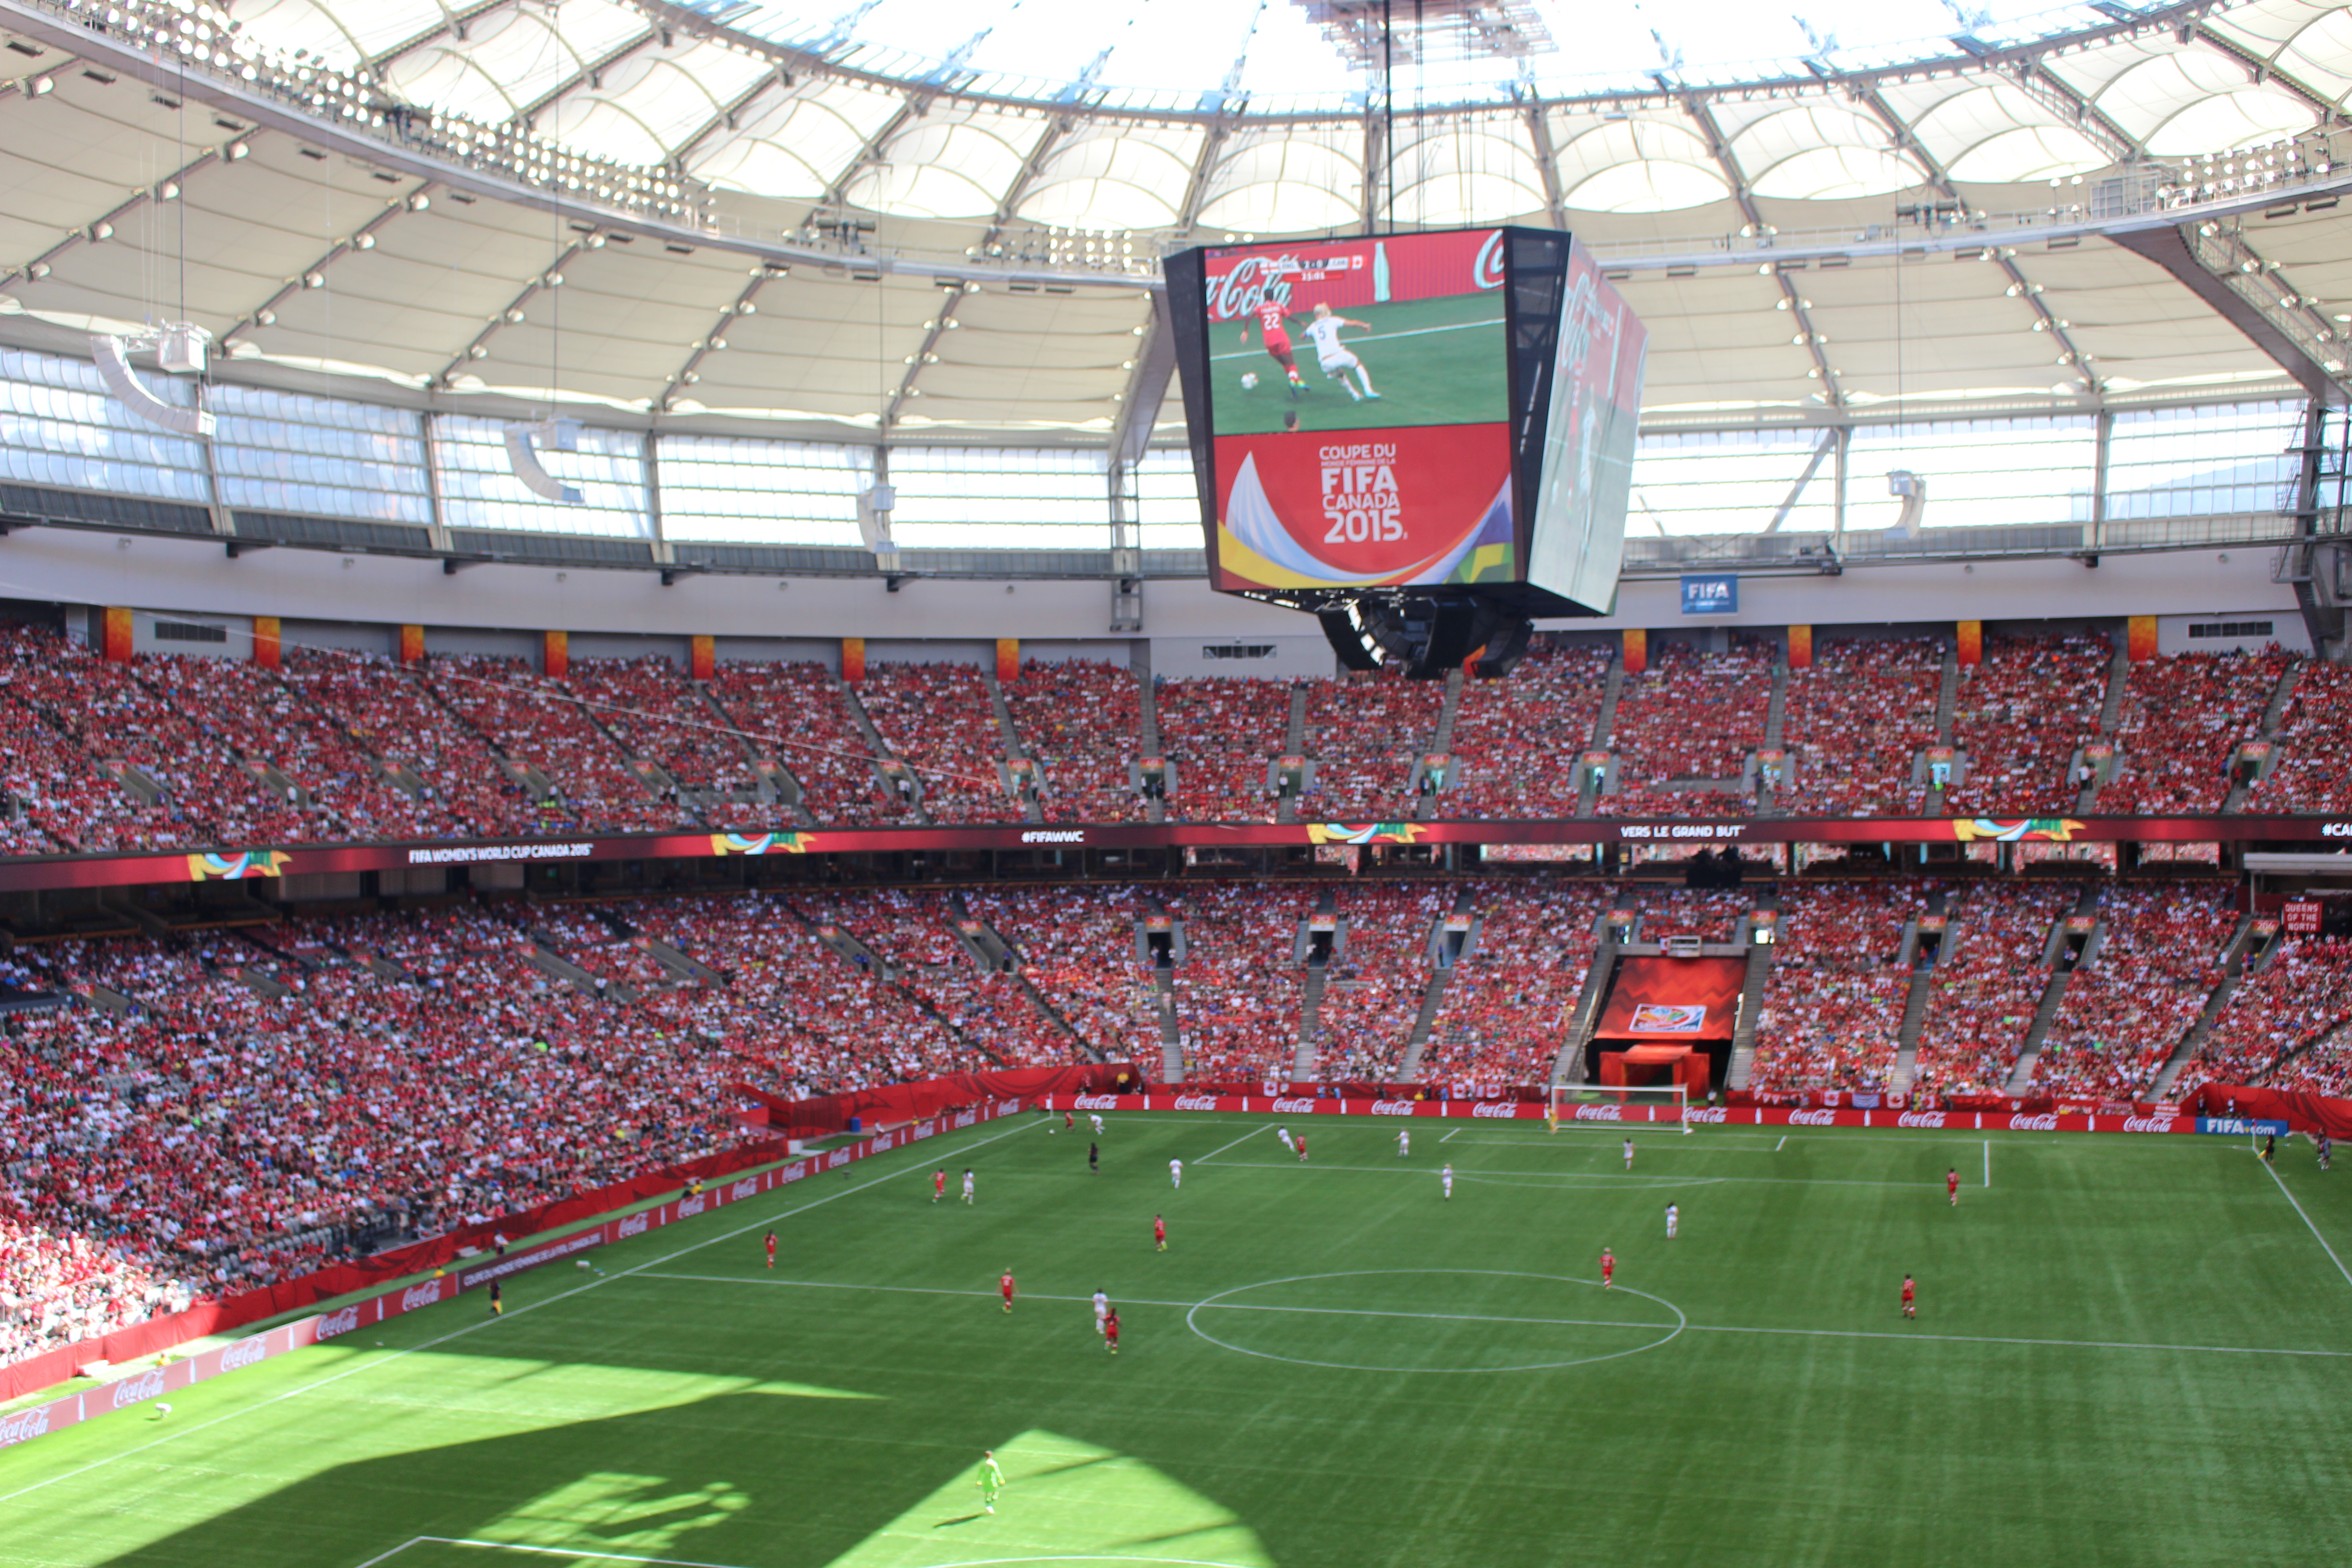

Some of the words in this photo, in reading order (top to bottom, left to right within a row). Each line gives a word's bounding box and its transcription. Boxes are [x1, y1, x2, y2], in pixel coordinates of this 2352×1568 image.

[1263, 313, 1280, 330] 22
[1318, 326, 1326, 340] 5
[1319, 444, 1371, 460] COUPE
[1373, 443, 1396, 458] DU
[1322, 465, 1399, 495] FIFA
[1322, 492, 1400, 510] CANADA
[1323, 508, 1403, 544] 2015
[1688, 582, 1730, 599] FIFA
[1021, 830, 1084, 843] #FIFAWWC
[1620, 825, 1651, 838] VERS
[1653, 825, 1669, 838] LE
[1671, 825, 1714, 838] GRAND
[2322, 823, 2352, 837] #CA
[408, 849, 432, 863] FIFA
[432, 847, 477, 862] WOMEN'S
[477, 845, 510, 860] WORLD
[511, 845, 531, 859] CUP
[531, 843, 570, 858] CANADA
[2285, 903, 2318, 912] QUEENS
[2287, 913, 2298, 921] OF
[2301, 912, 2317, 921] THE
[2256, 921, 2274, 931] 204
[2287, 922, 2316, 931] NORTH
[2206, 1118, 2277, 1135] FIFA.com
